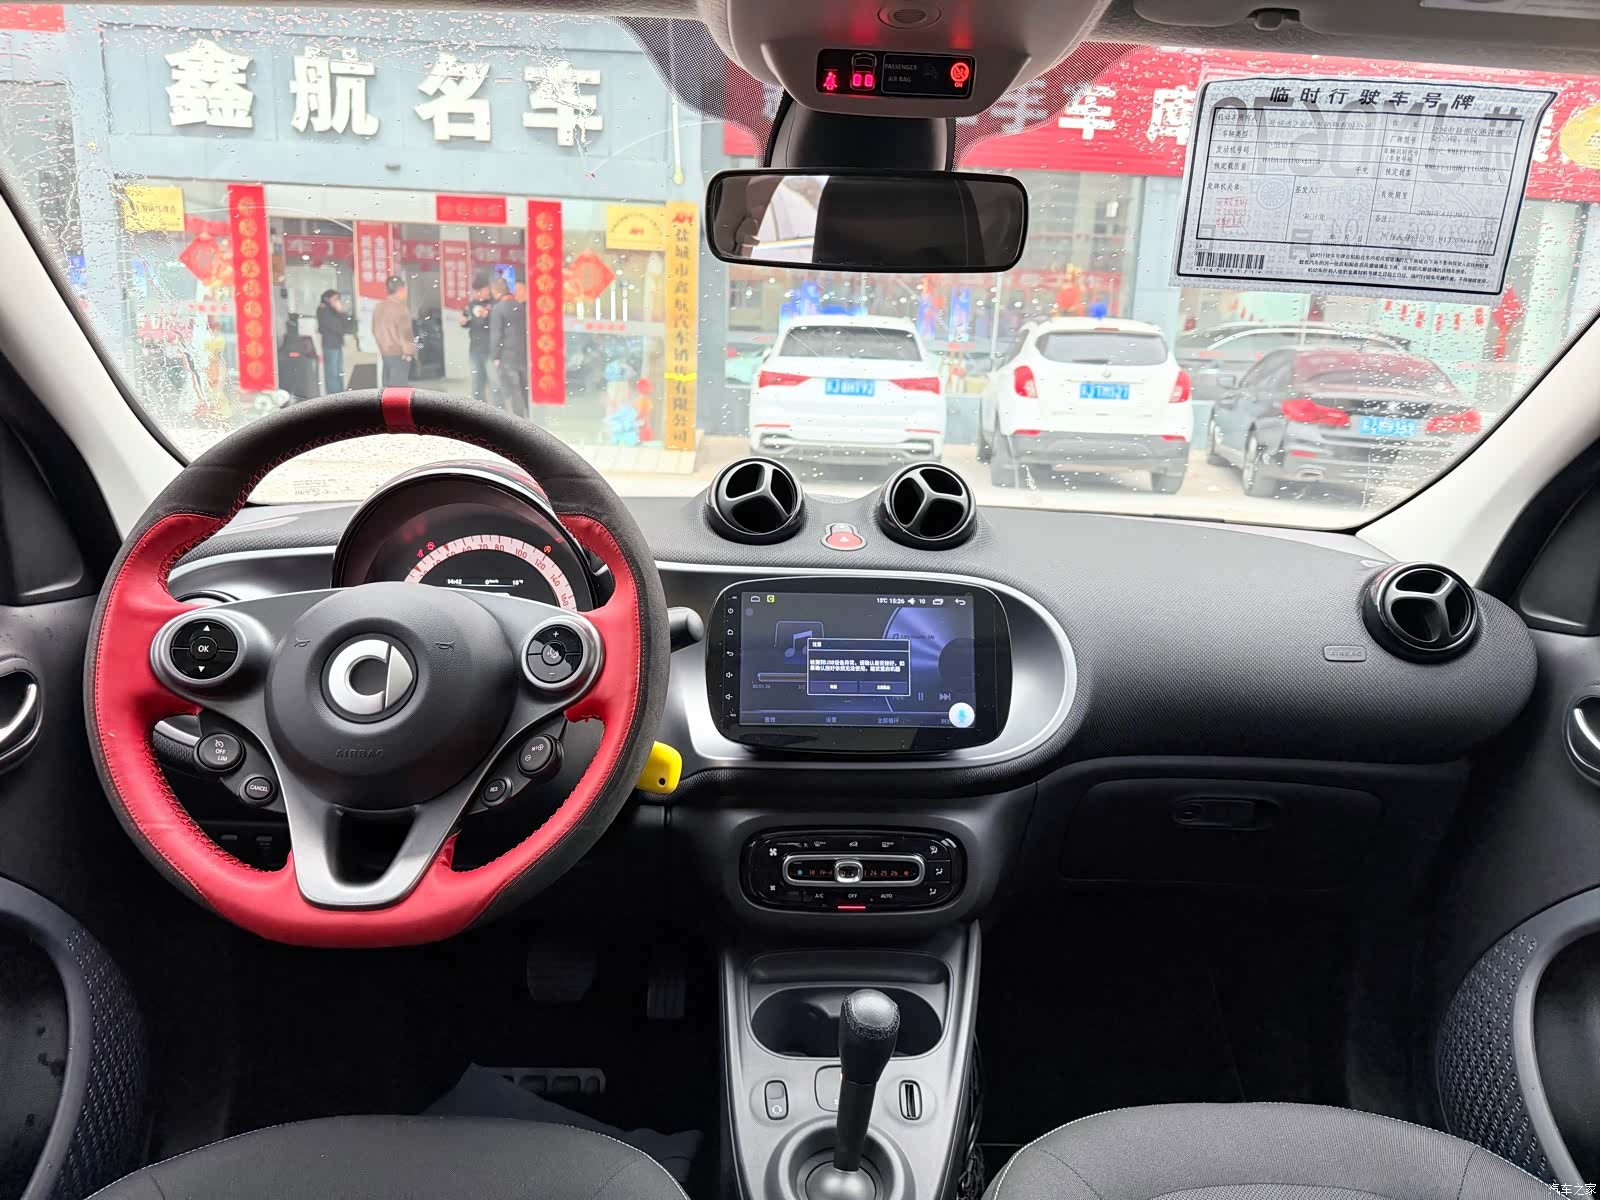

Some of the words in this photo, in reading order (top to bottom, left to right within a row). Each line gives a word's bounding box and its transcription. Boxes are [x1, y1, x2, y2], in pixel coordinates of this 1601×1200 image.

[885, 63, 918, 71] PASSENGER
[164, 38, 604, 147] 鑫航名车
[1270, 86, 1476, 110] 临时行驶车号牌
[515, 549, 528, 559] 100
[534, 558, 546, 571] 120
[550, 574, 561, 587] 140
[560, 593, 569, 607] 160
[198, 645, 209, 653] OK
[250, 784, 268, 792] CANCEL
